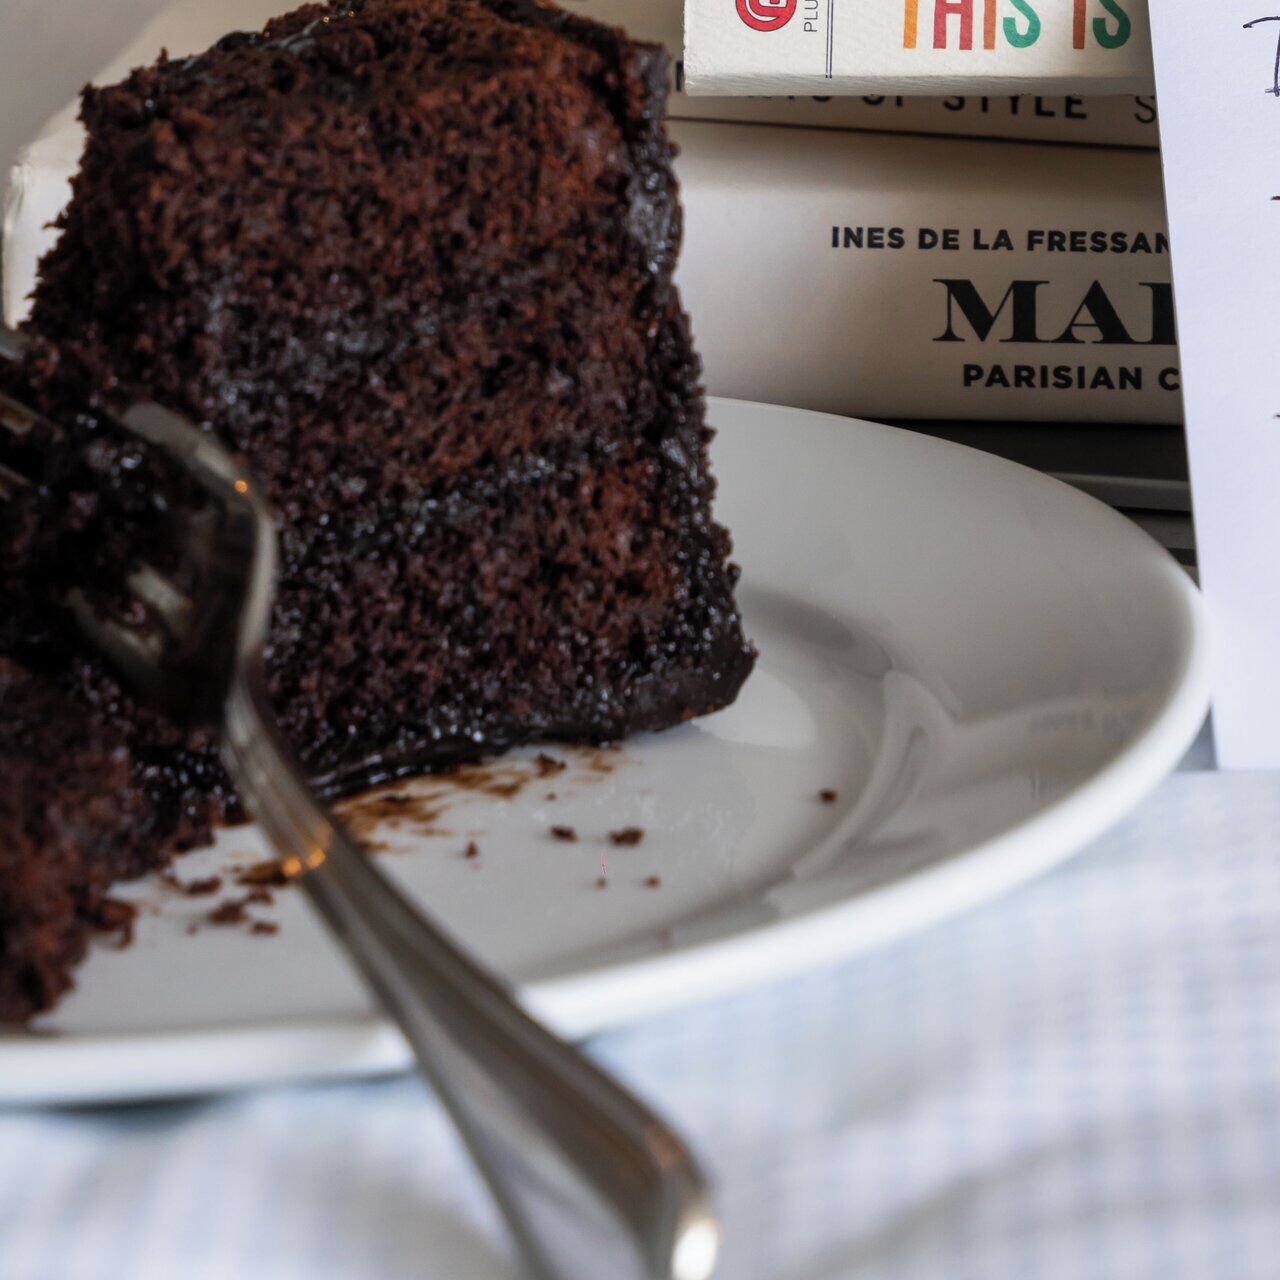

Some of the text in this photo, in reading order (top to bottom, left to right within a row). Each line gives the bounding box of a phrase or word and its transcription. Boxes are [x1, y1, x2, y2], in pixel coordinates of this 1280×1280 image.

[831, 226, 905, 250] INES
[918, 228, 960, 251] DE
[973, 228, 1013, 252] LA
[962, 364, 1142, 389] PARISIAN
